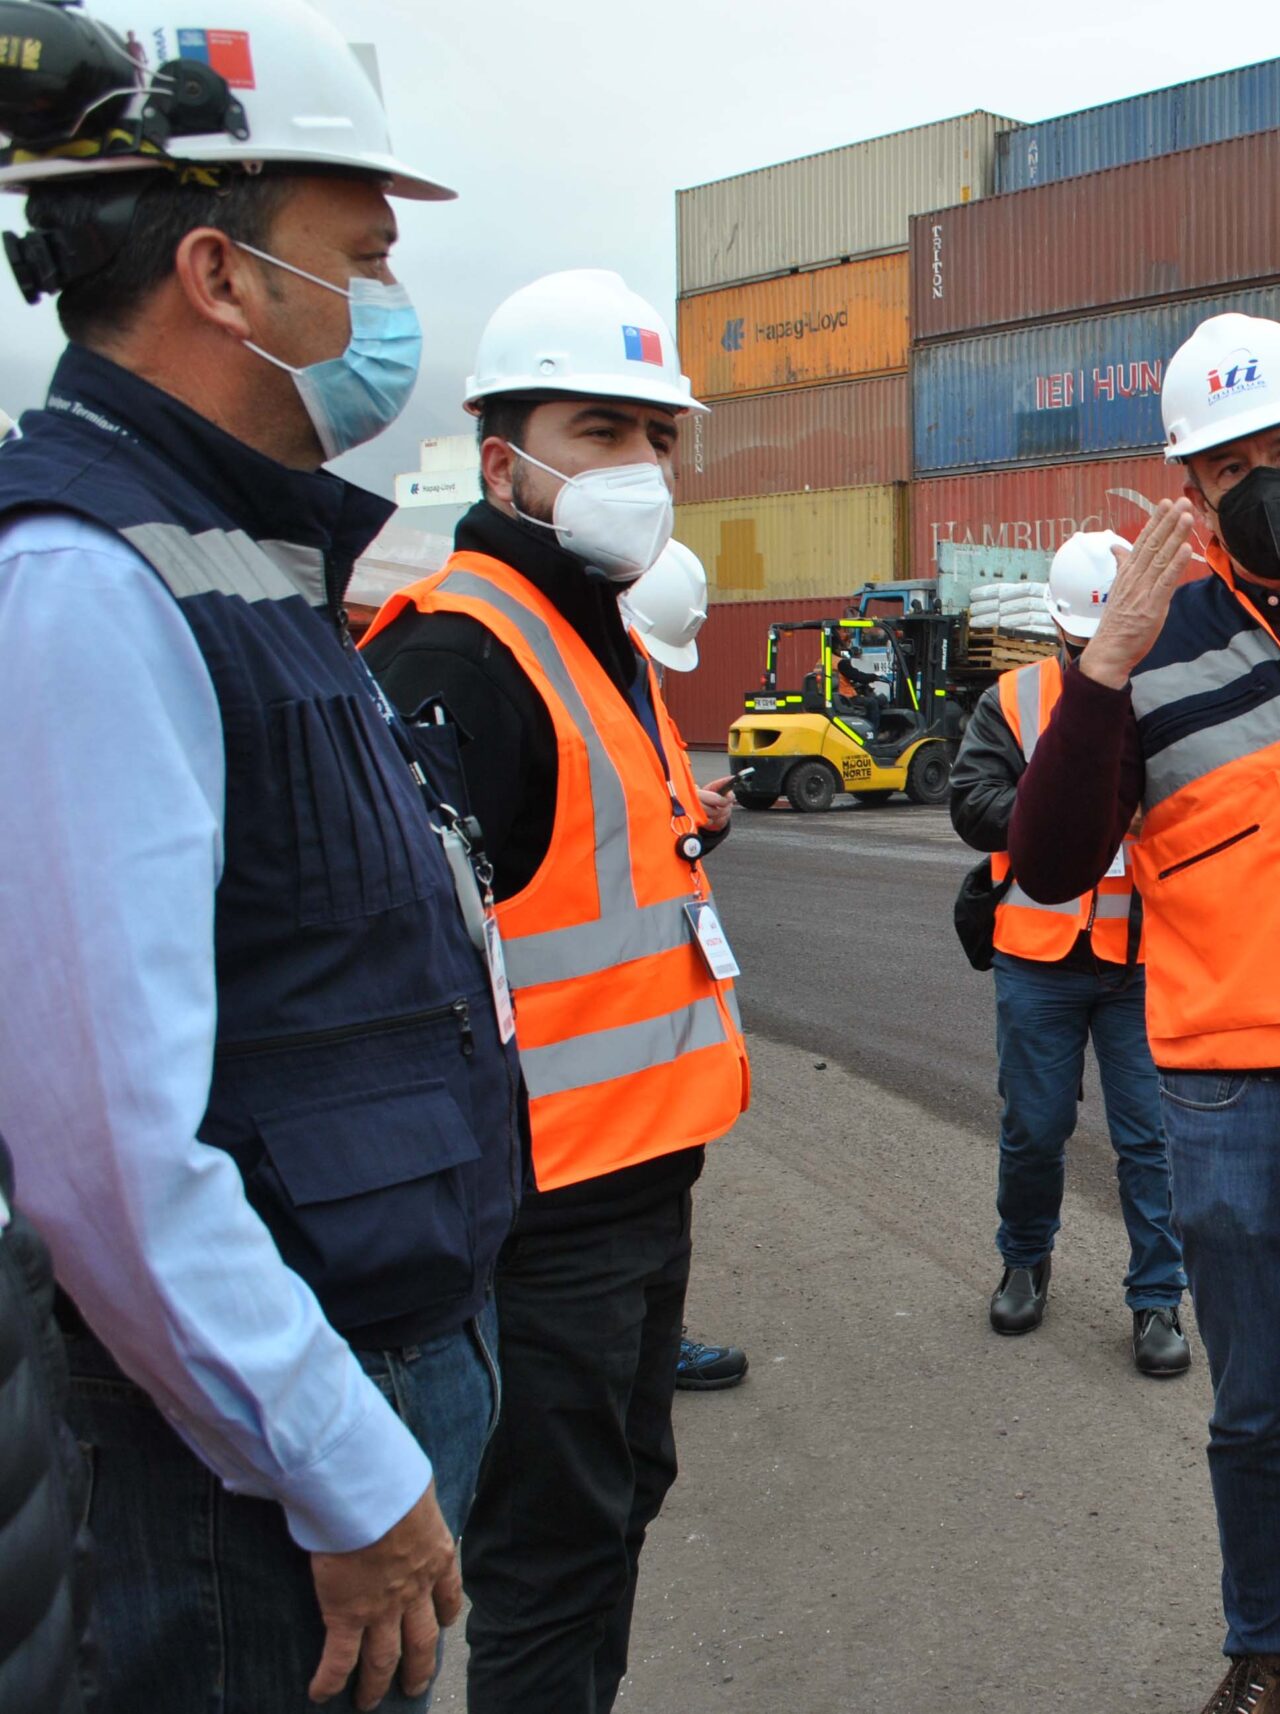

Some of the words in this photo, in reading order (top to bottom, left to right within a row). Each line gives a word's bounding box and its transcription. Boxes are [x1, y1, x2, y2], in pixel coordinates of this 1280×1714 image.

[932, 225, 943, 299] TRITON
[755, 305, 849, 344] Hapag-Lloyd
[842, 768, 872, 779] NORTE
